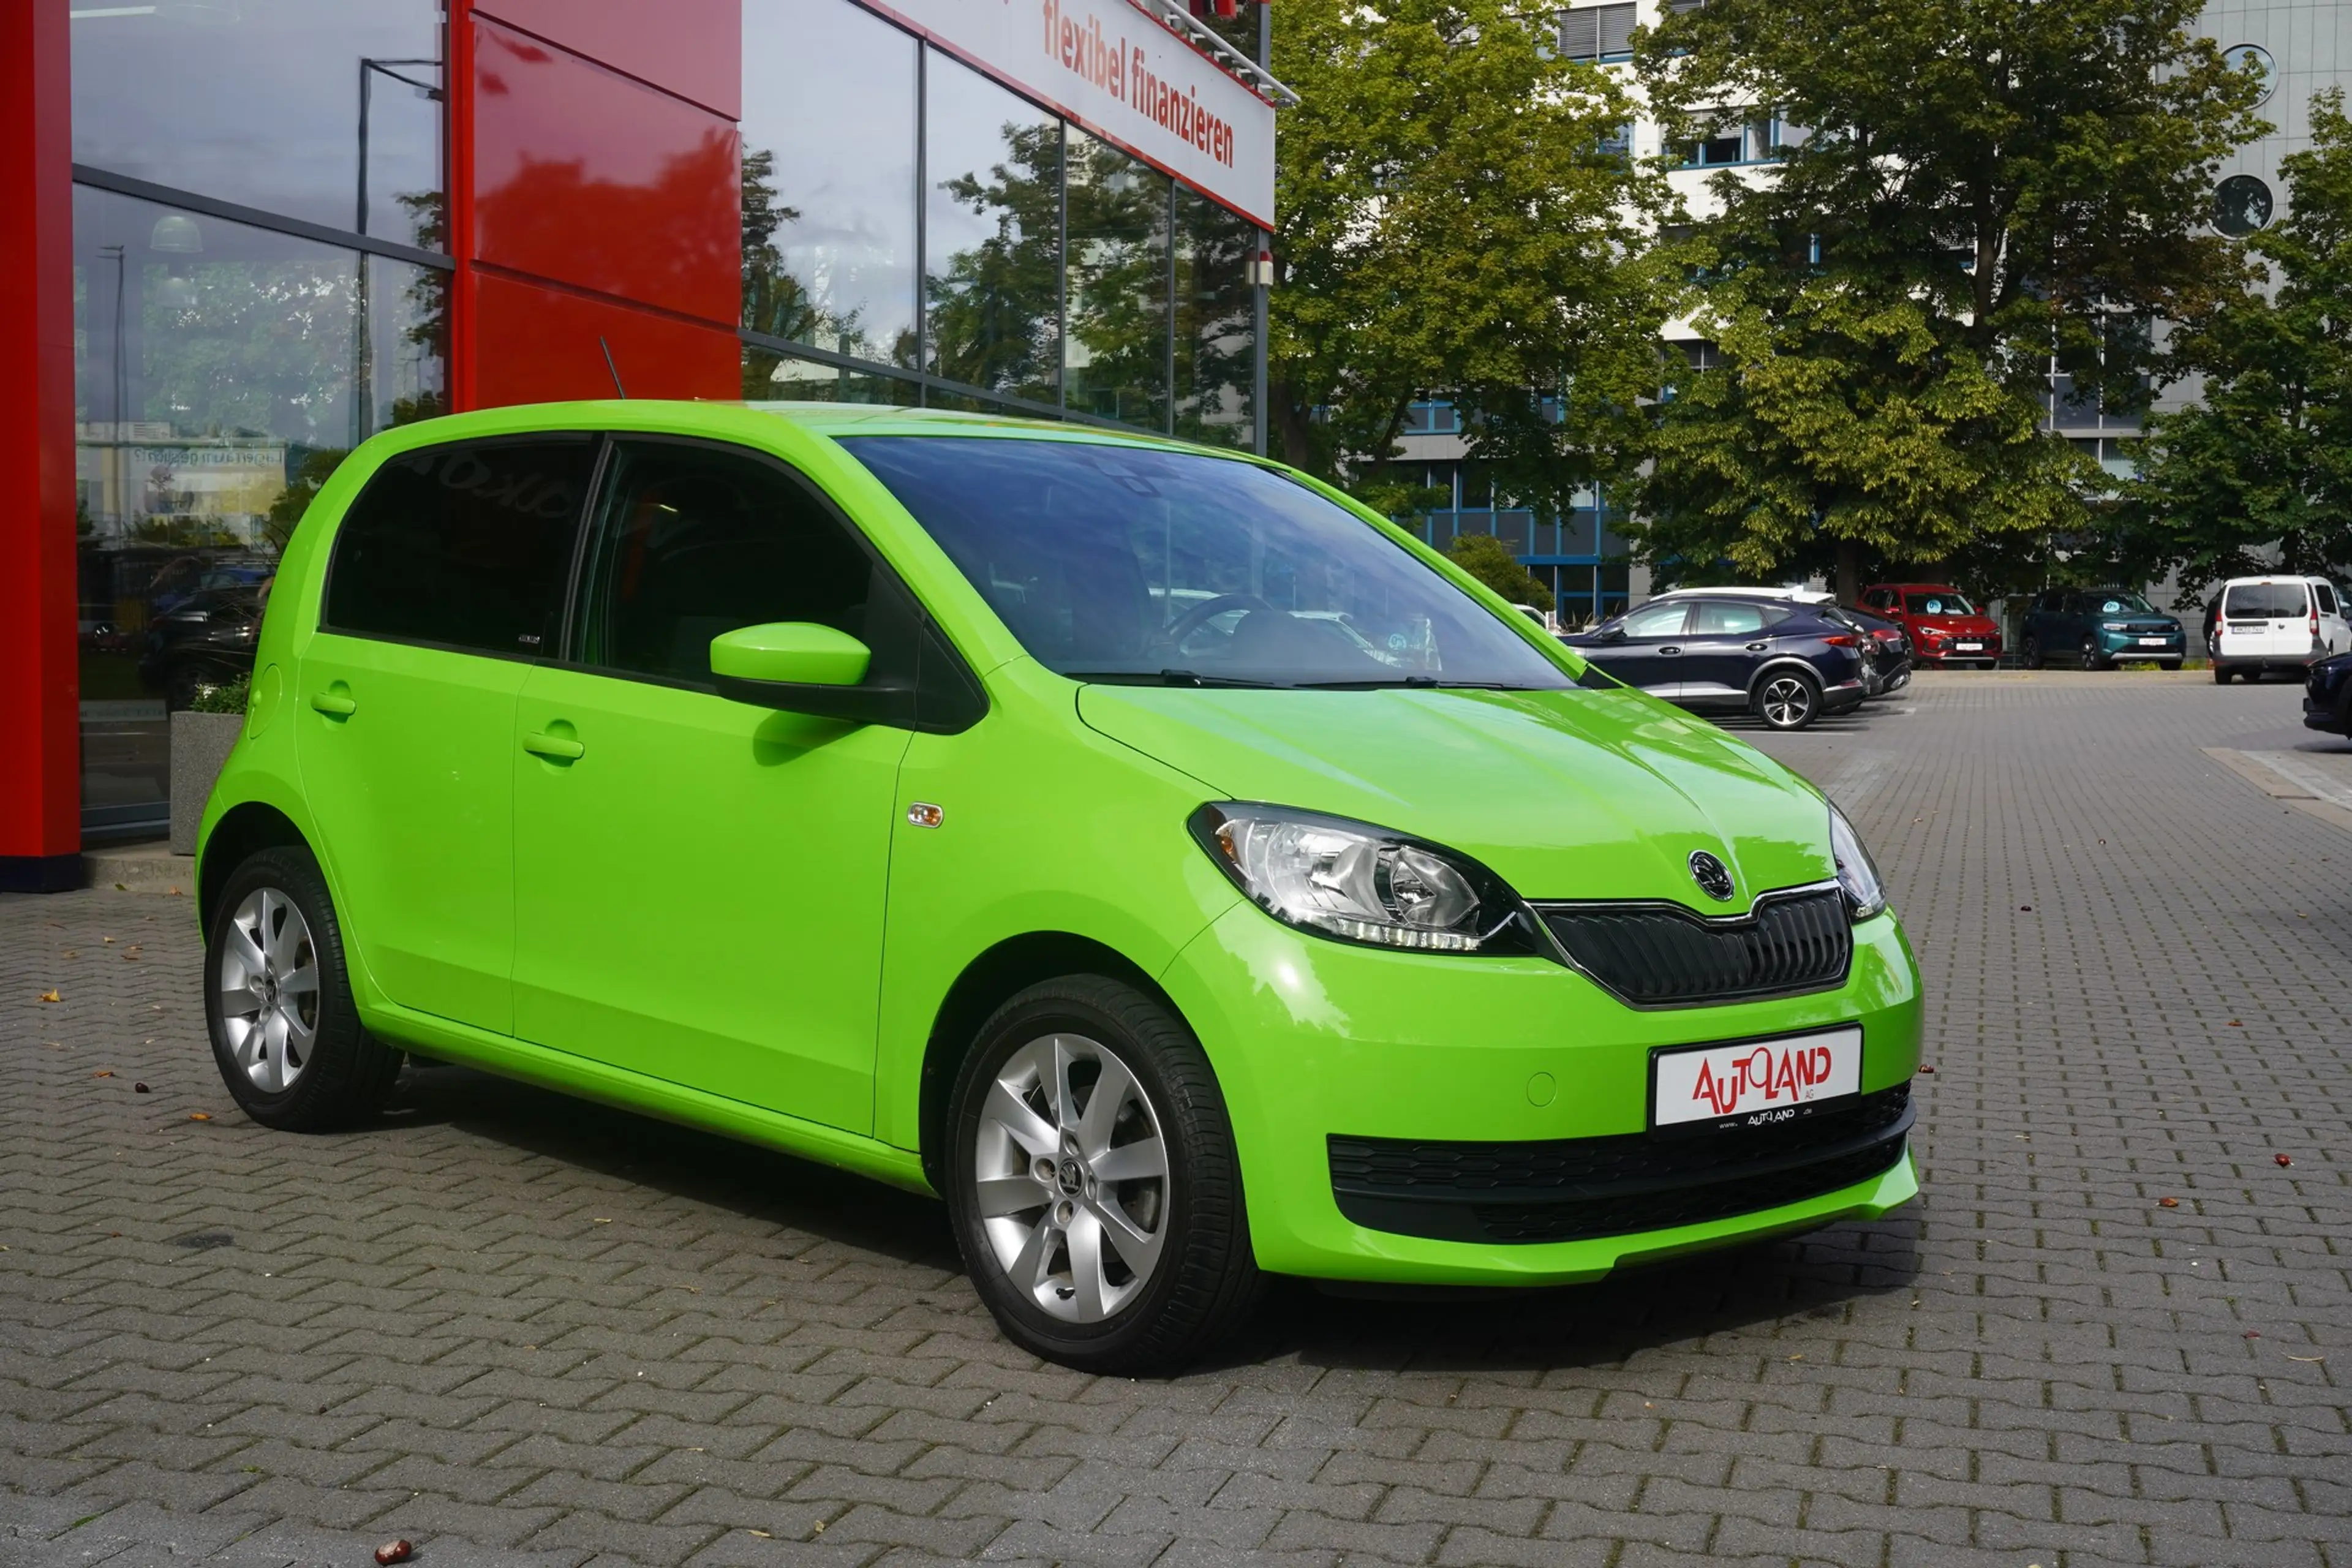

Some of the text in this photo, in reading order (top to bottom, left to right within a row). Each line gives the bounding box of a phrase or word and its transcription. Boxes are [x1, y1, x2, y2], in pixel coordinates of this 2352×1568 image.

[1043, 0, 1234, 168] flexibel finanzieren
[1692, 1047, 1831, 1114] AUTOLAND
[1804, 1088, 1814, 1100] AG
